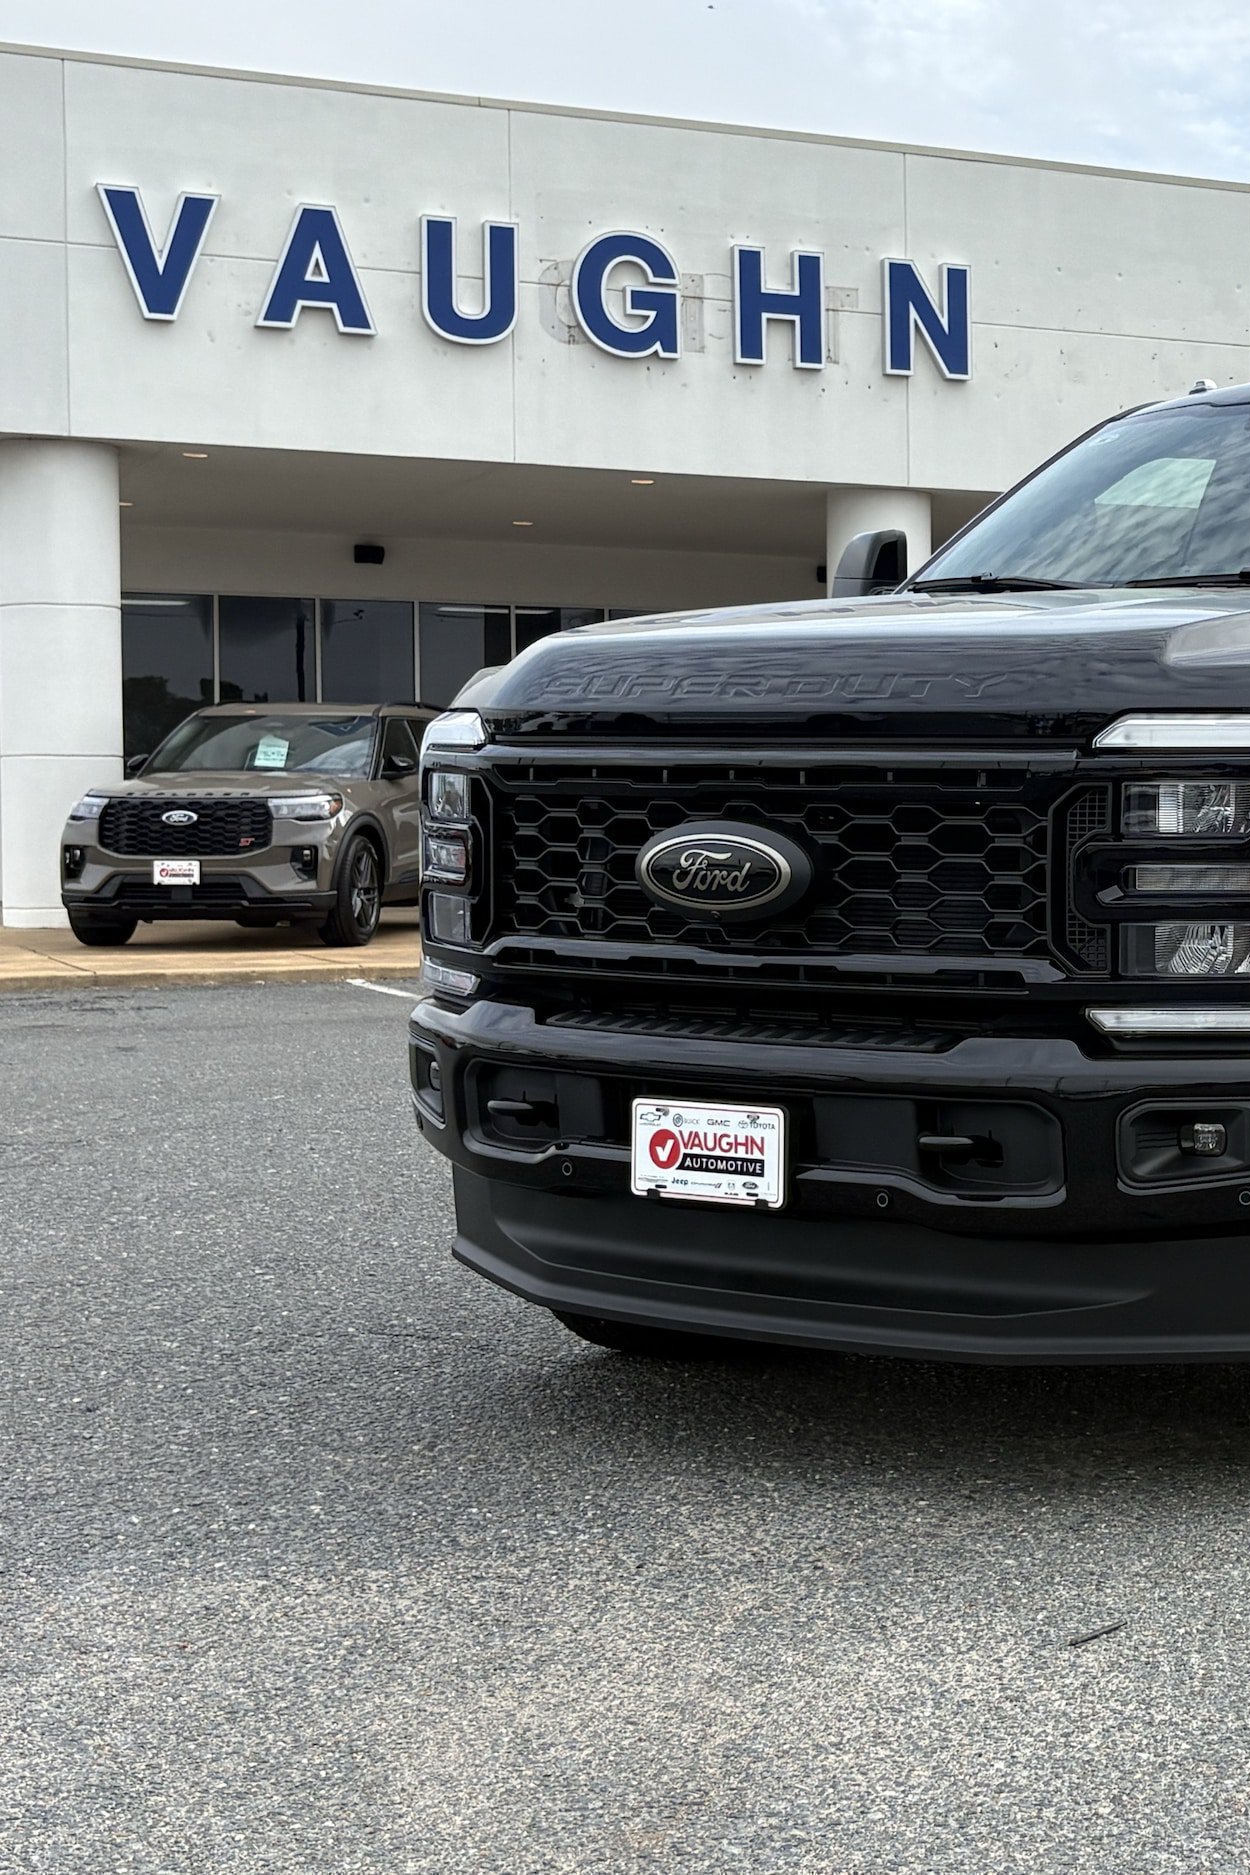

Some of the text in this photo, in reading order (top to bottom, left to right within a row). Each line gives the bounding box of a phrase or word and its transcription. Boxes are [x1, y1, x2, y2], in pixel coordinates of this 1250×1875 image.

[96, 182, 973, 382] VAUGHN
[542, 672, 1008, 699] SUPER DUTY
[672, 849, 752, 893] Ford
[706, 1118, 731, 1128] GMC
[749, 1119, 776, 1130] TOYOTA
[678, 1129, 765, 1157] VAUGHN
[684, 1157, 763, 1174] AUTOMOTIVE
[671, 1176, 689, 1187] Jeep
